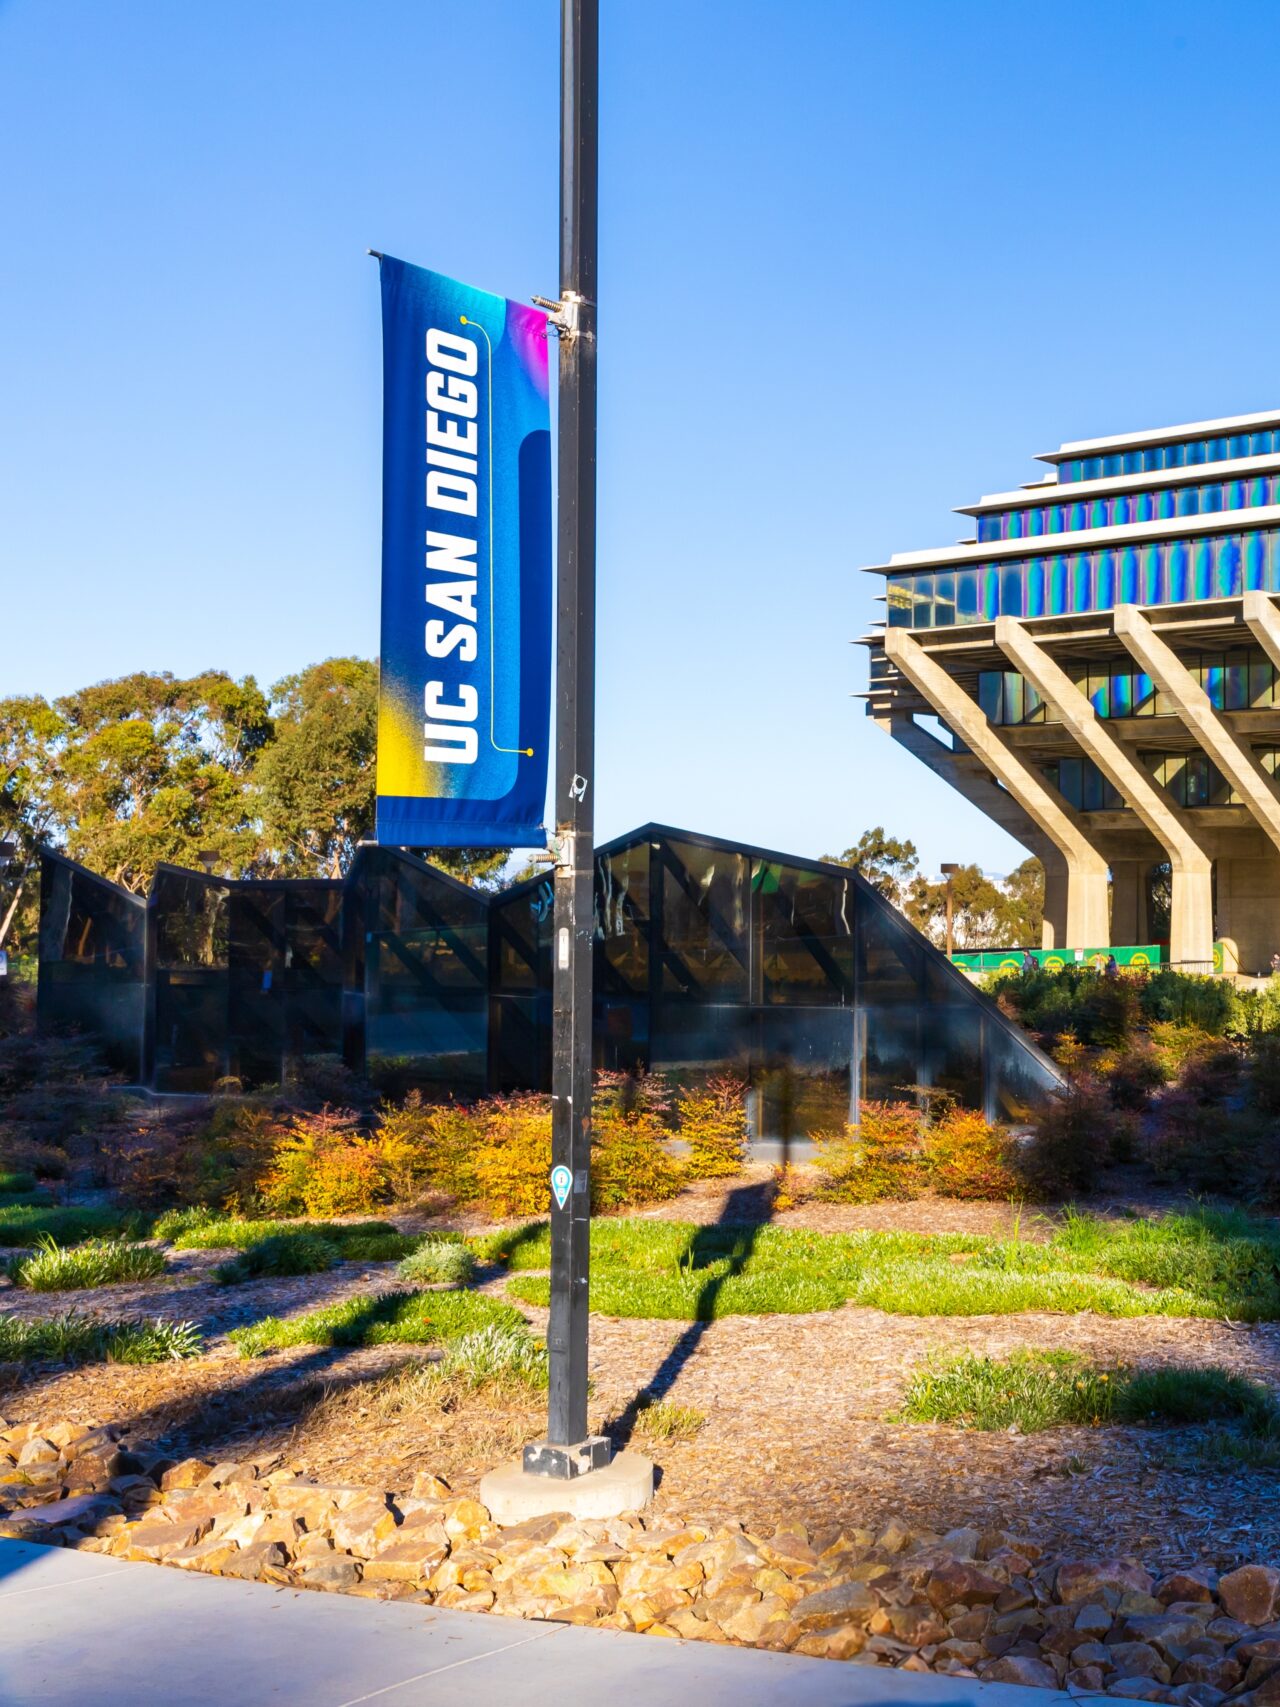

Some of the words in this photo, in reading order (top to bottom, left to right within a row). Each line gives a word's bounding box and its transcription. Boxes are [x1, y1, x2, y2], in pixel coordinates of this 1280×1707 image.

[426, 327, 478, 518] DIEGO
[425, 530, 478, 662] SAN
[424, 681, 478, 765] UC
